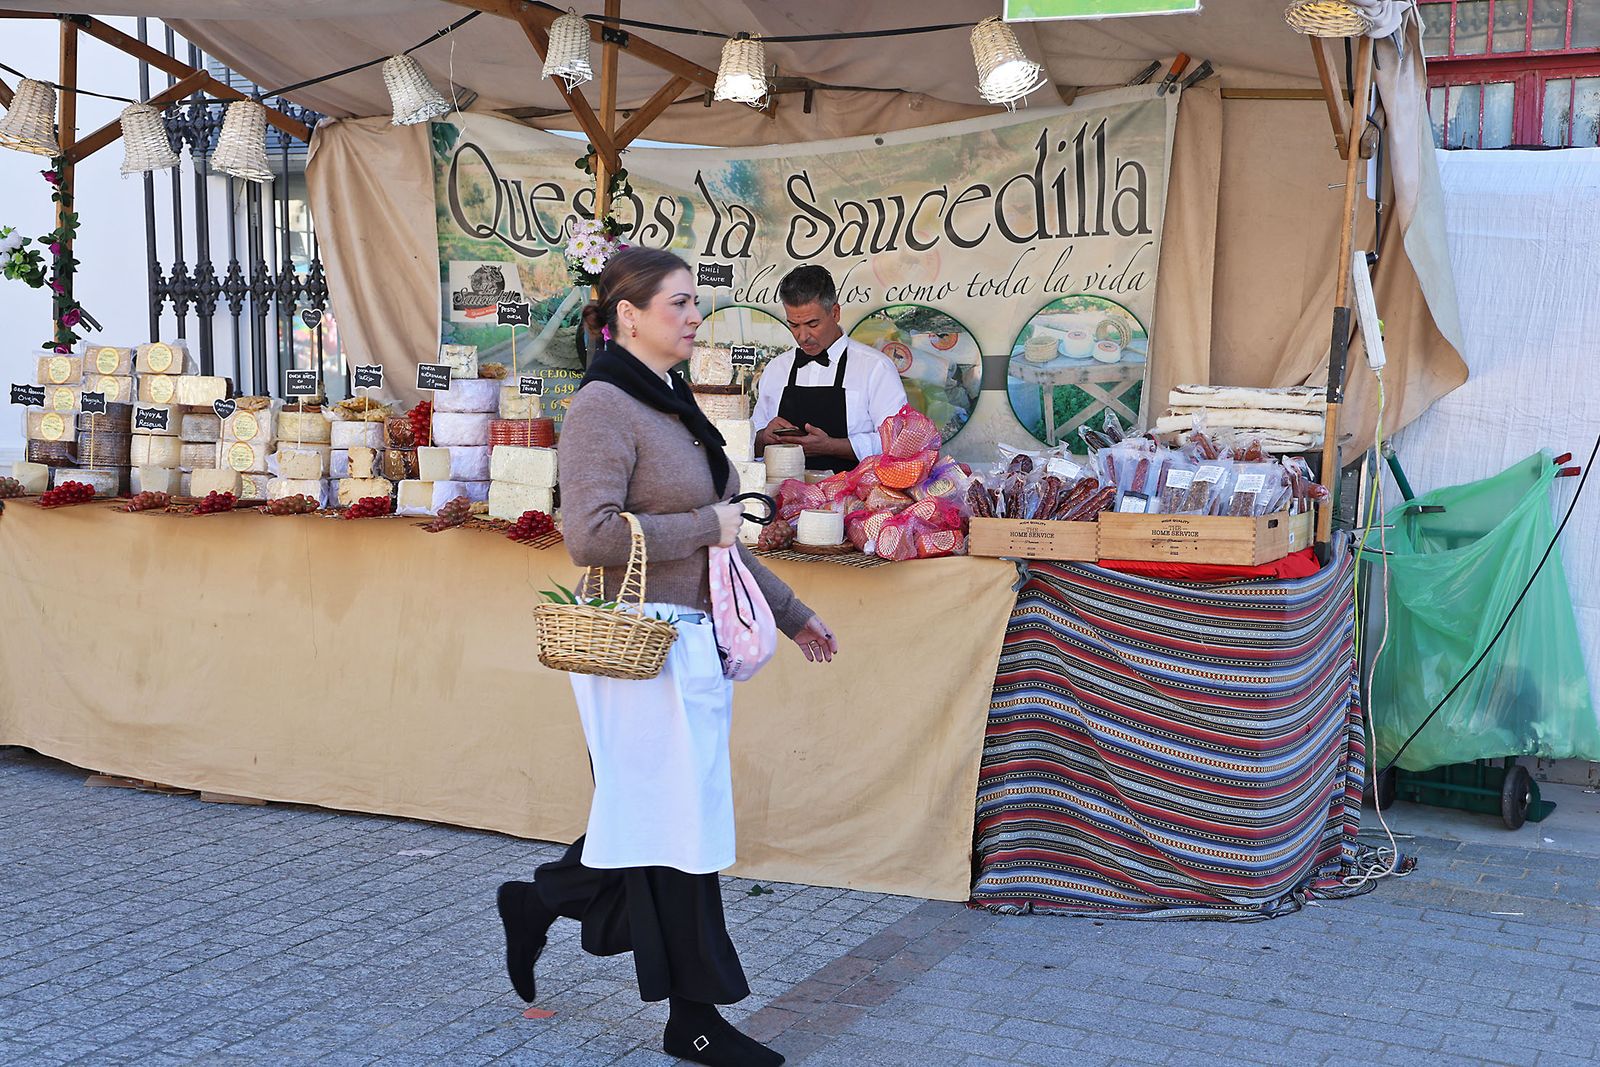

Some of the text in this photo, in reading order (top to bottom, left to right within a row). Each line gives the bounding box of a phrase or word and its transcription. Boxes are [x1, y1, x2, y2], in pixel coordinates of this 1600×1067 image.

[447, 117, 1153, 260] Quesos la Saucedilla
[885, 281, 960, 302] como
[966, 247, 1037, 299] toda
[1043, 245, 1076, 293] la
[1082, 241, 1153, 294] vida
